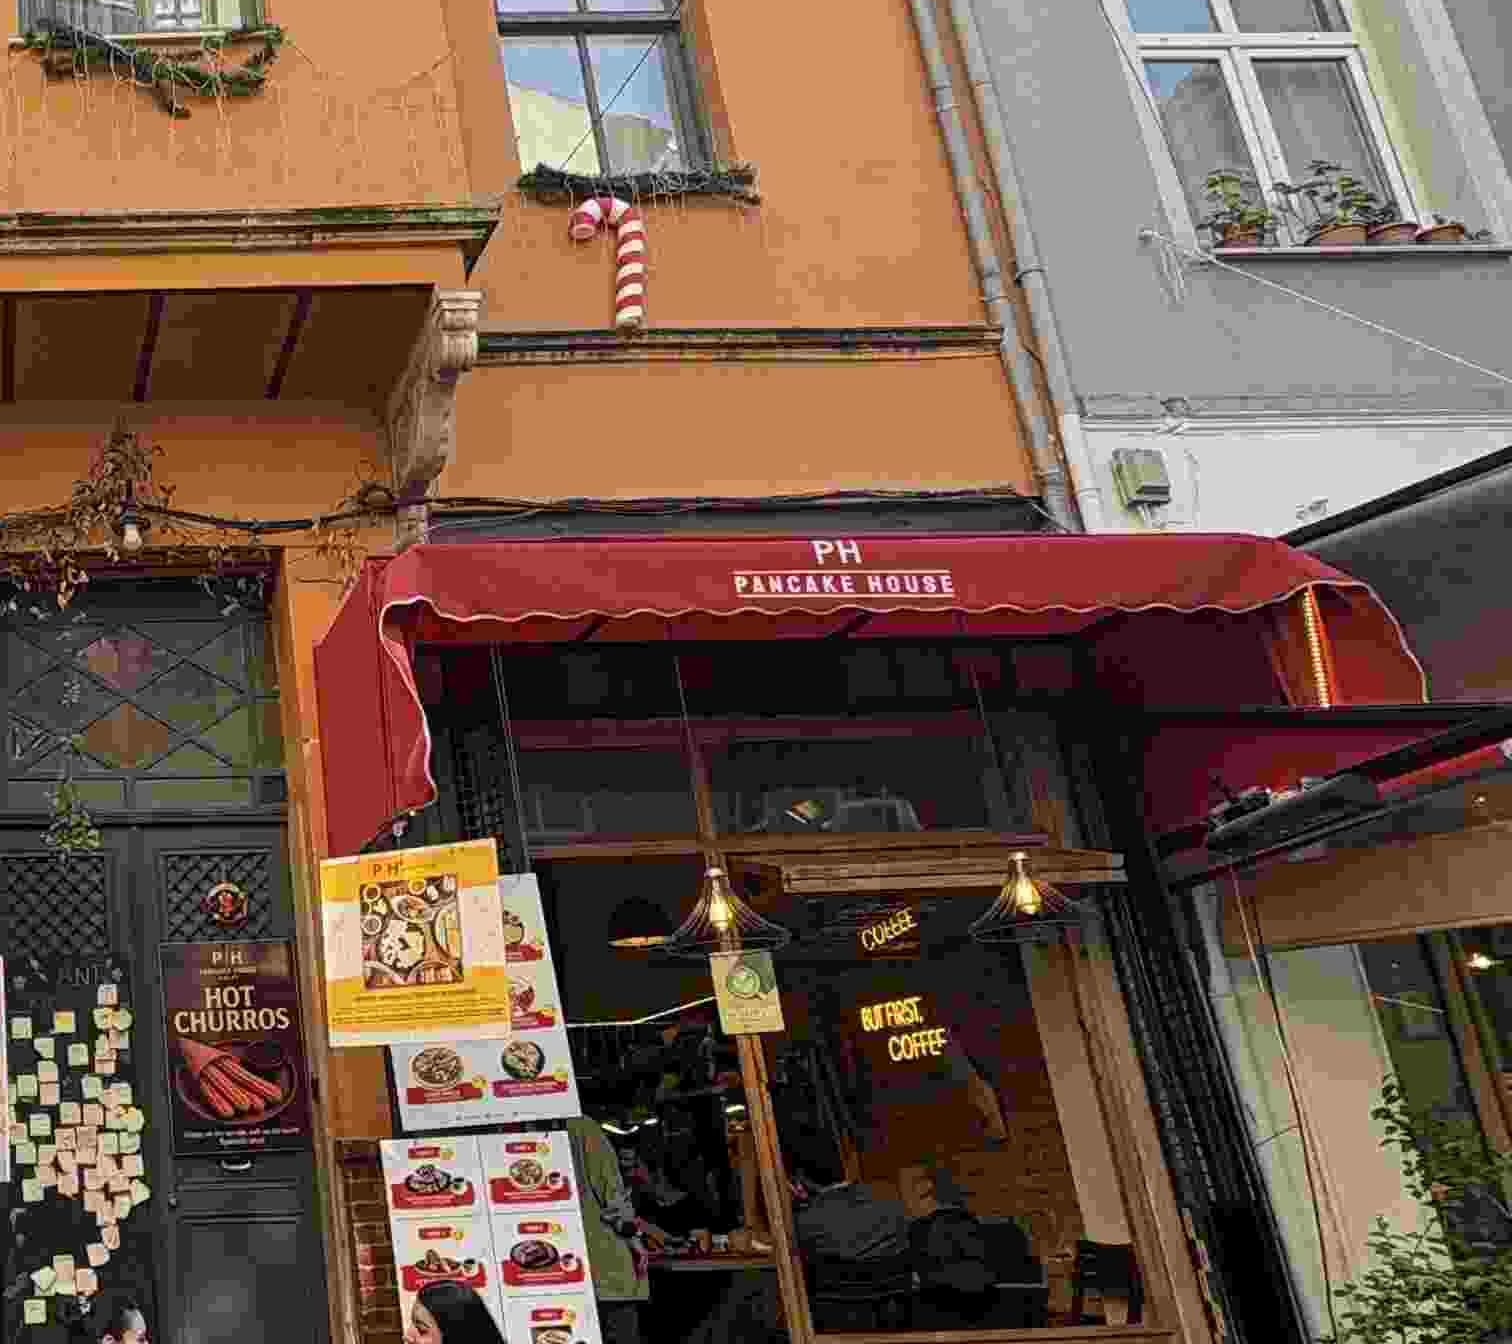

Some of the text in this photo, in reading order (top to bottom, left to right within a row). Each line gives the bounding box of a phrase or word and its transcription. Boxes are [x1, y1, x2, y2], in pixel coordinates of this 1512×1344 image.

[811, 539, 863, 565] PH
[733, 575, 953, 593] PANCAKE HOUSE
[203, 984, 256, 1009] HOT
[173, 1007, 290, 1033] CHURROS
[888, 1026, 948, 1062] COFFEE
